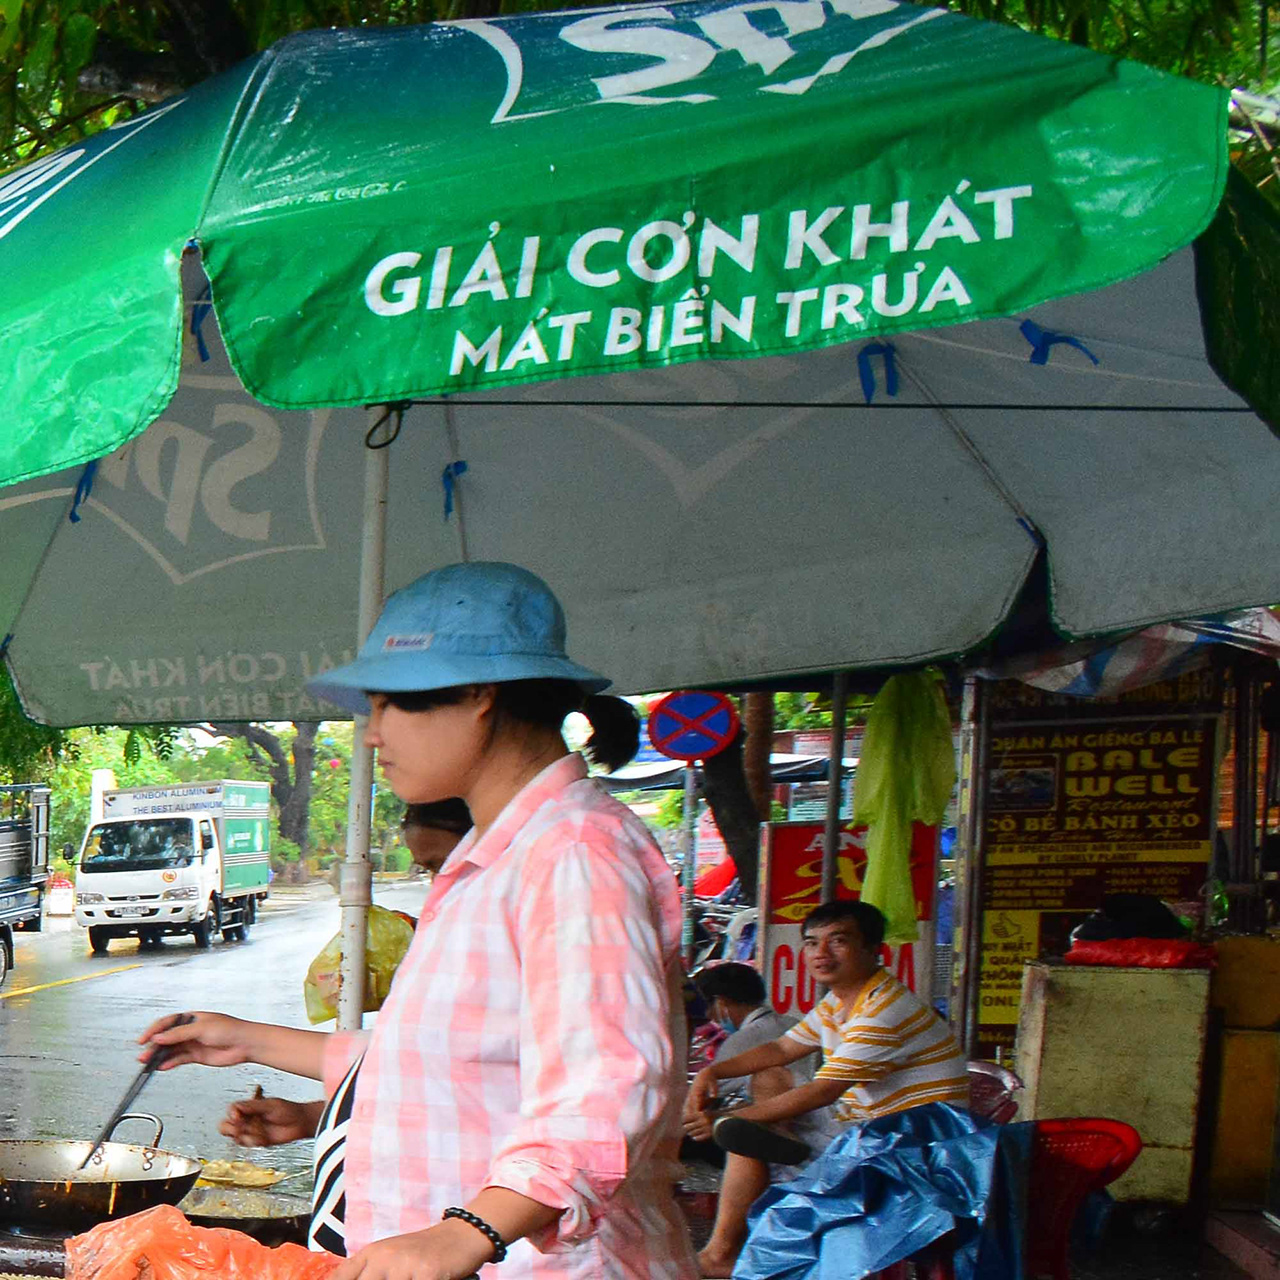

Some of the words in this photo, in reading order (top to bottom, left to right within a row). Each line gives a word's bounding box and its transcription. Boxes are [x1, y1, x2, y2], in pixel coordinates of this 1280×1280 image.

[365, 221, 540, 316] GIẢI
[567, 210, 759, 288] CƠN
[783, 180, 1032, 269] KHÁT
[450, 307, 592, 376] MÁT
[603, 284, 755, 356] BIỂN
[775, 261, 971, 338] TRƯA
[1065, 747, 1200, 772] BALE
[132, 790, 168, 801] KINBON
[1064, 774, 1200, 797] WELL
[133, 806, 149, 815] THE
[151, 805, 173, 814] BEST
